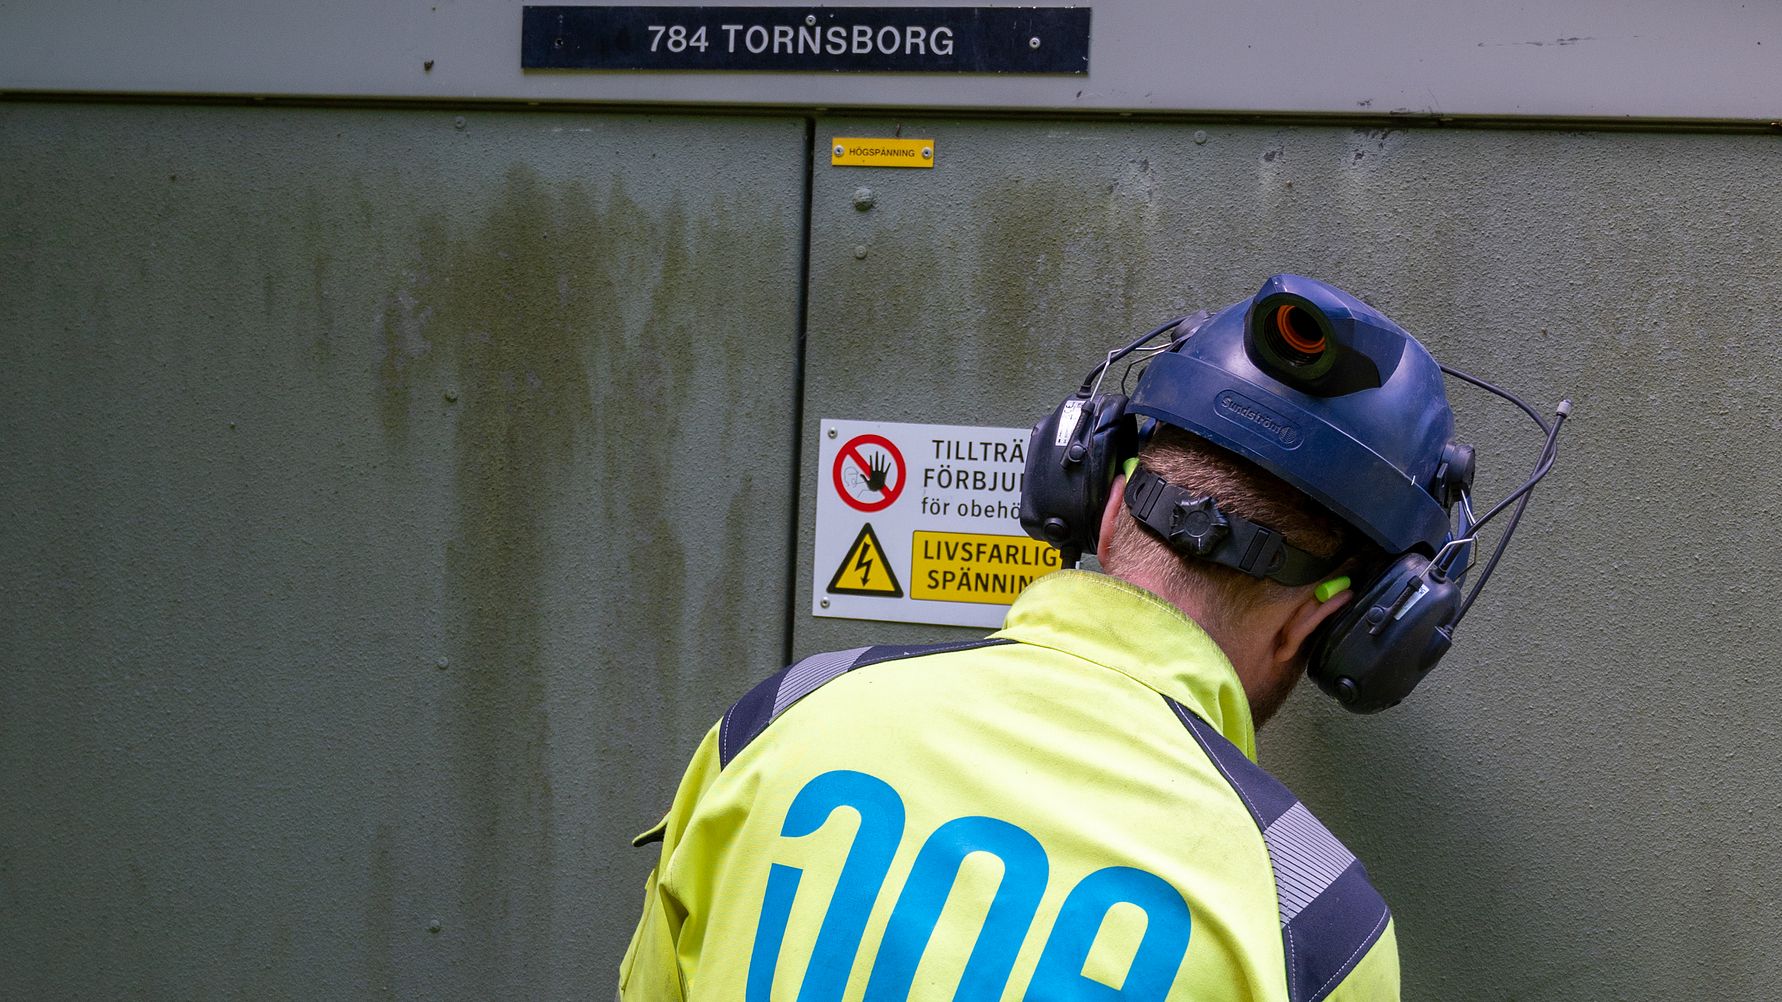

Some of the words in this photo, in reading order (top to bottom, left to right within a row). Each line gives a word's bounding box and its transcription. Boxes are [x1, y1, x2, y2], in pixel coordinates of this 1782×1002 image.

[648, 24, 709, 54] 784
[722, 24, 954, 55] TORNSBORG
[849, 146, 916, 158] HÖGSPÄNNING
[1221, 395, 1281, 434] Sundström
[932, 438, 1024, 463] TILLTRÄ
[923, 464, 1025, 493] FÖRBJU
[921, 496, 950, 515] för
[957, 500, 1021, 520] obehö
[924, 539, 1058, 568] LIVSFARLIG
[927, 566, 1033, 595] SPÄNNIN
